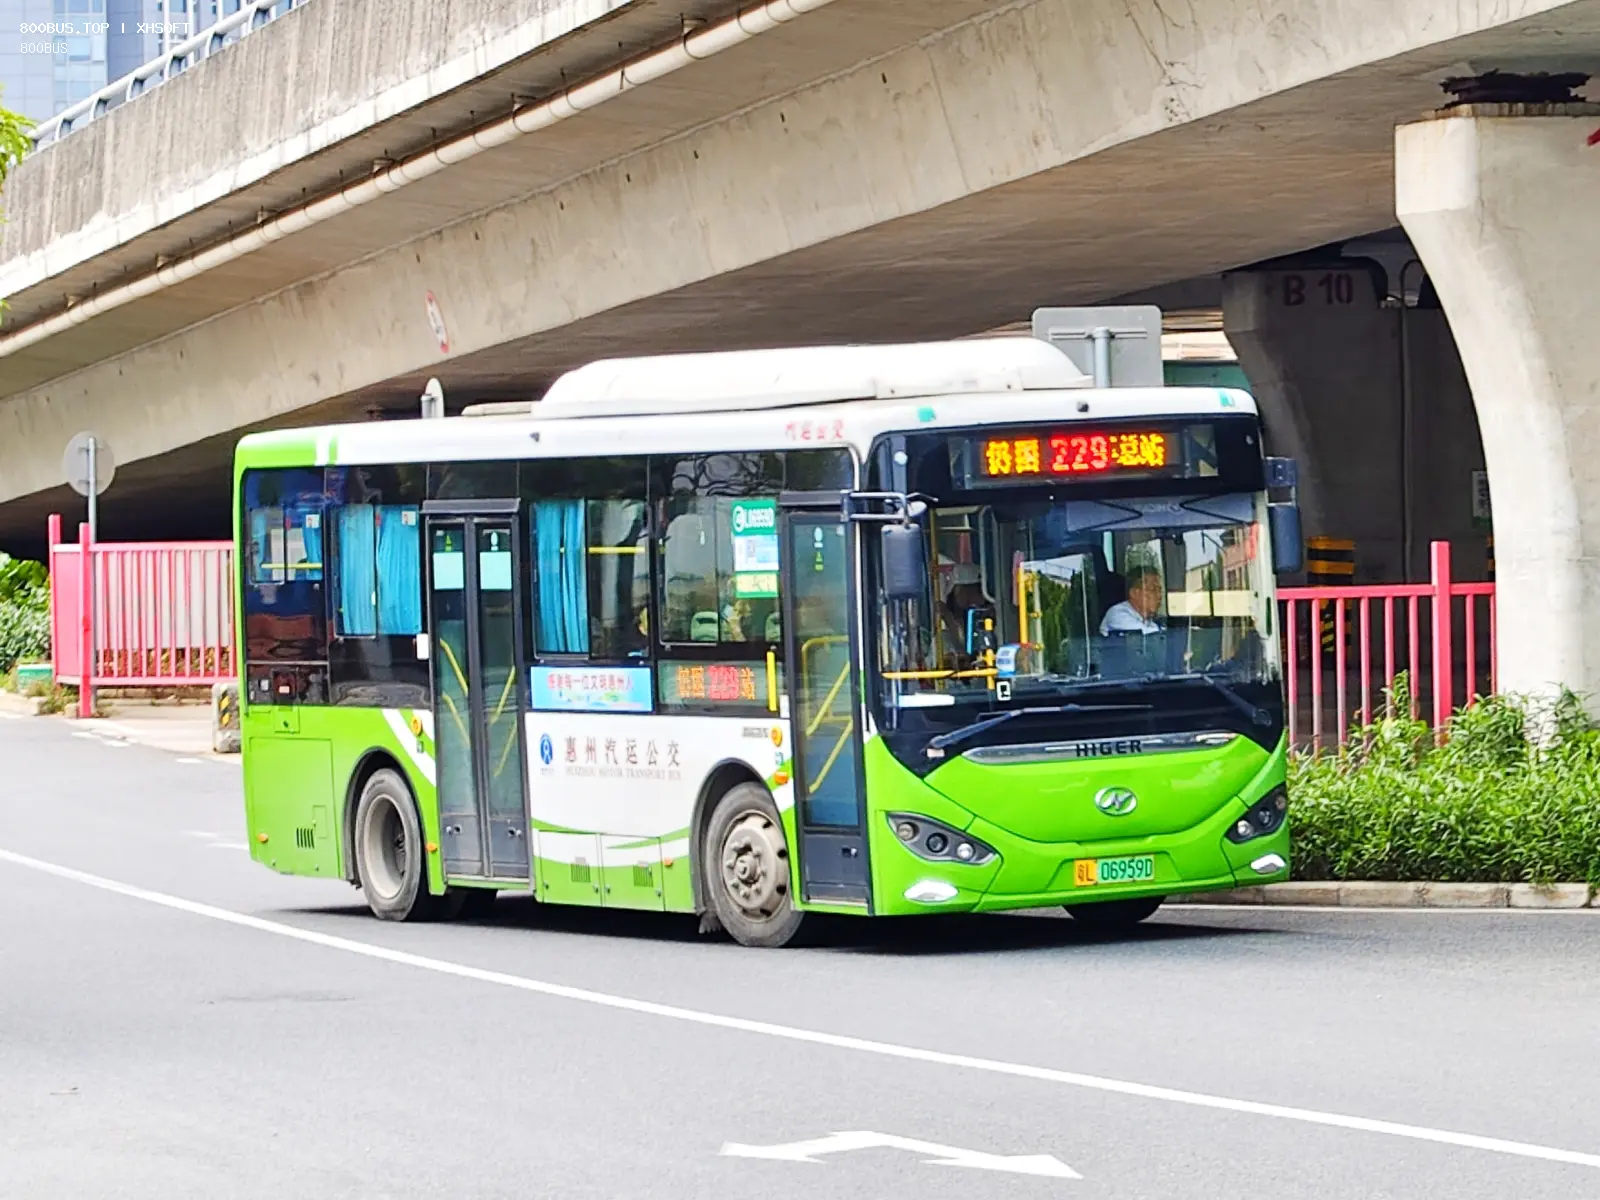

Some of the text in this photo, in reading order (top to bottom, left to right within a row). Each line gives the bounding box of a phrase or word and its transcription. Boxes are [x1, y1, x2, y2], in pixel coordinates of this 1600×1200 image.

[1283, 272, 1353, 306] B 10
[1050, 435, 1108, 472] 229
[564, 736, 681, 767] 惠州汽运公交
[1076, 739, 1142, 757] HIGER
[1101, 858, 1153, 881] 06959D
